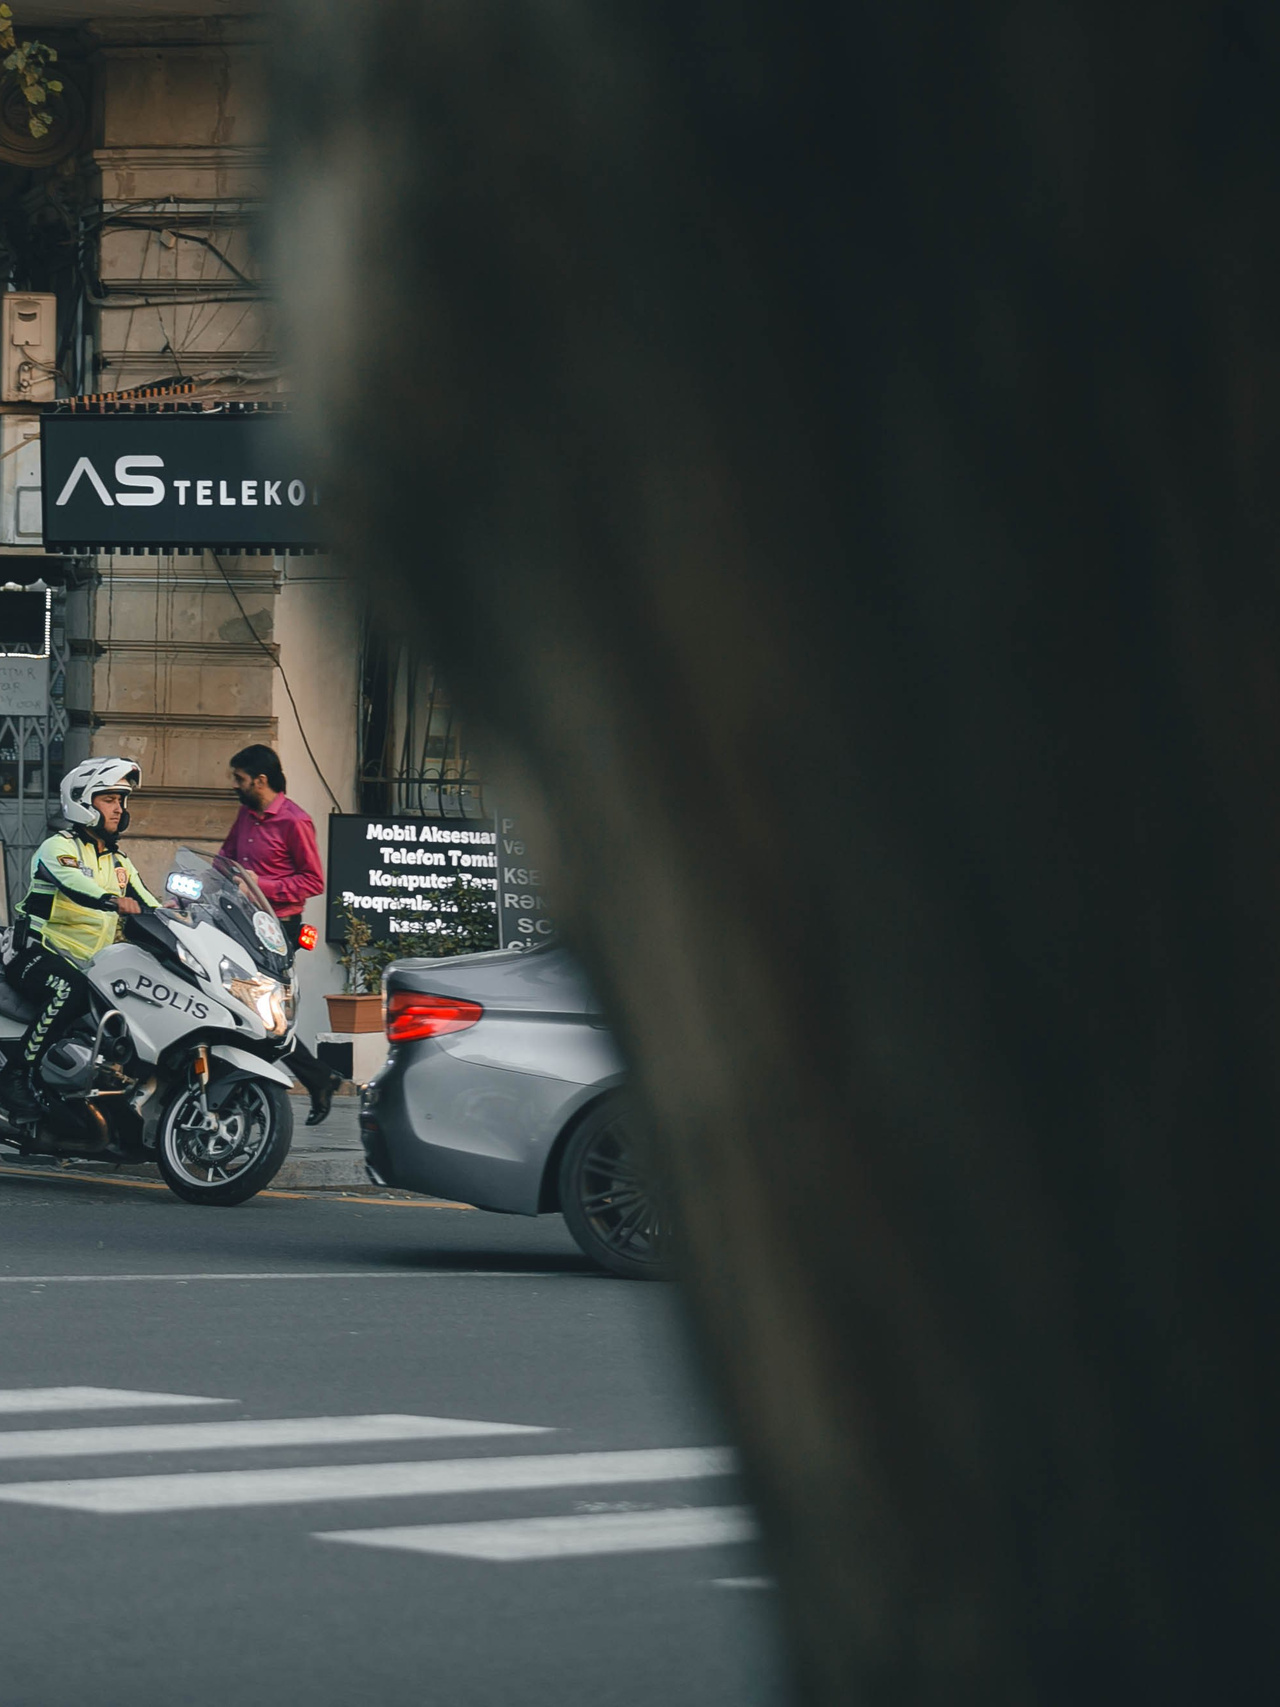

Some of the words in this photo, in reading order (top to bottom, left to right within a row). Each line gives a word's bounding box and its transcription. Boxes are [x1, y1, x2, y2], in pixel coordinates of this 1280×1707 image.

[55, 454, 165, 507] AS
[173, 478, 319, 507] TELEKO
[366, 823, 417, 842] Mobil
[380, 847, 446, 866] Telefon
[135, 975, 210, 1020] POLİS
